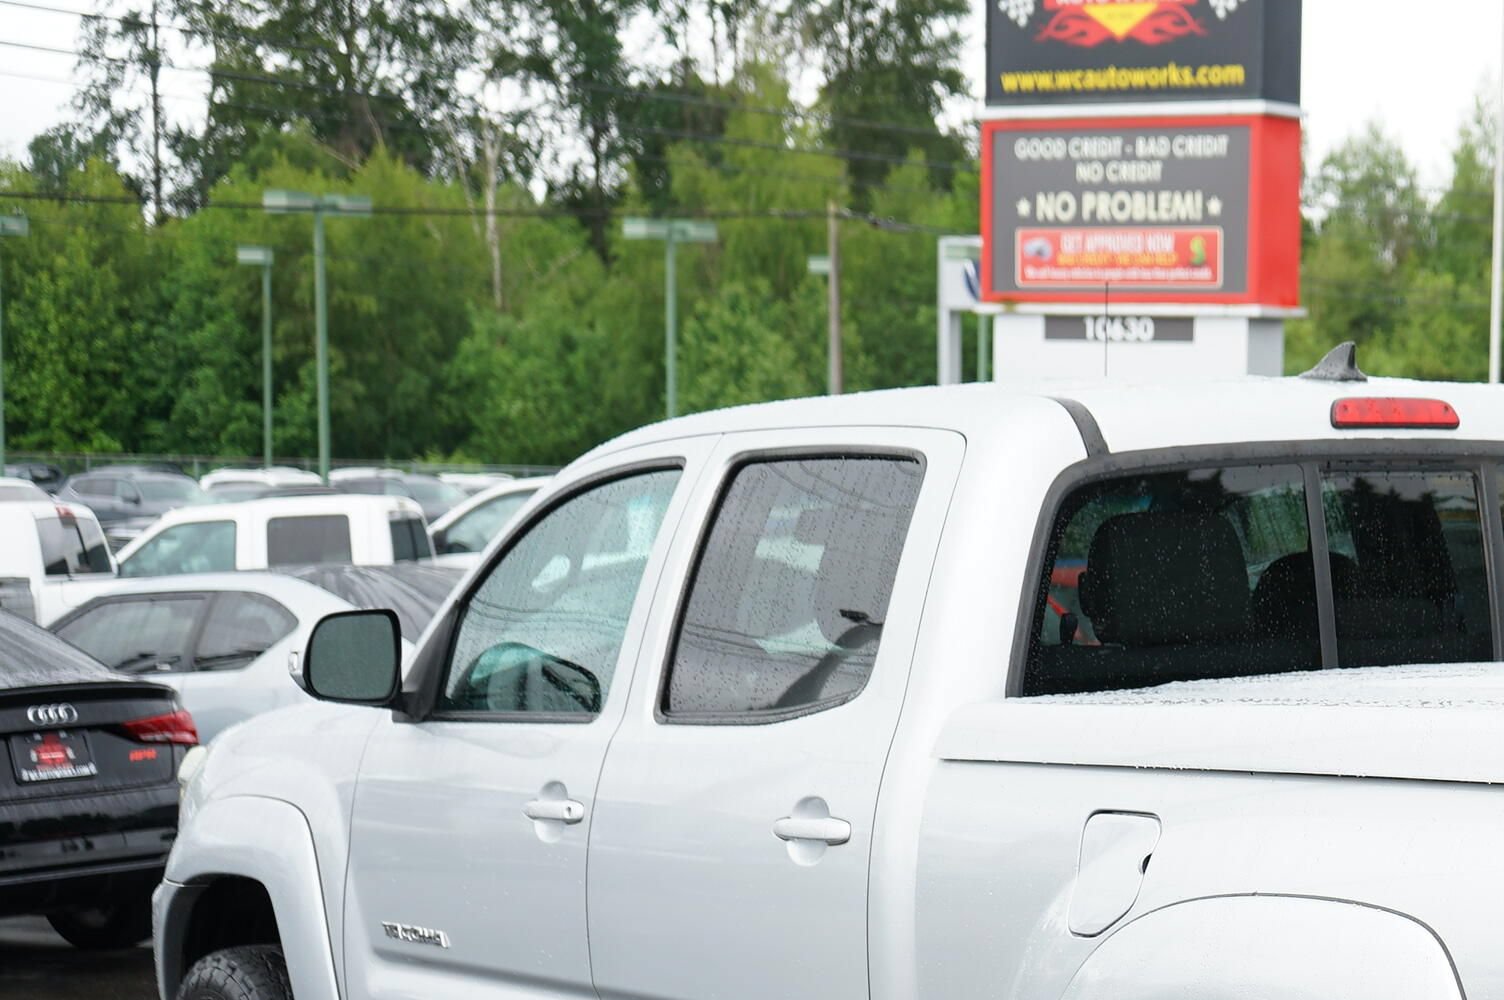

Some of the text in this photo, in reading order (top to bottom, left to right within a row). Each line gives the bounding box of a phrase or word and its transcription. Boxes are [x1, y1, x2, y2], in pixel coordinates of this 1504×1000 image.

[1000, 62, 1246, 93] www.wcautoworks.com
[1014, 137, 1067, 160] GOOD
[1068, 136, 1123, 159] CREDIT
[1135, 135, 1171, 159] BAD
[1172, 133, 1229, 158] CREDIT
[1075, 159, 1163, 183] NO CREDIT
[1036, 188, 1204, 222] NO PROBLEM!
